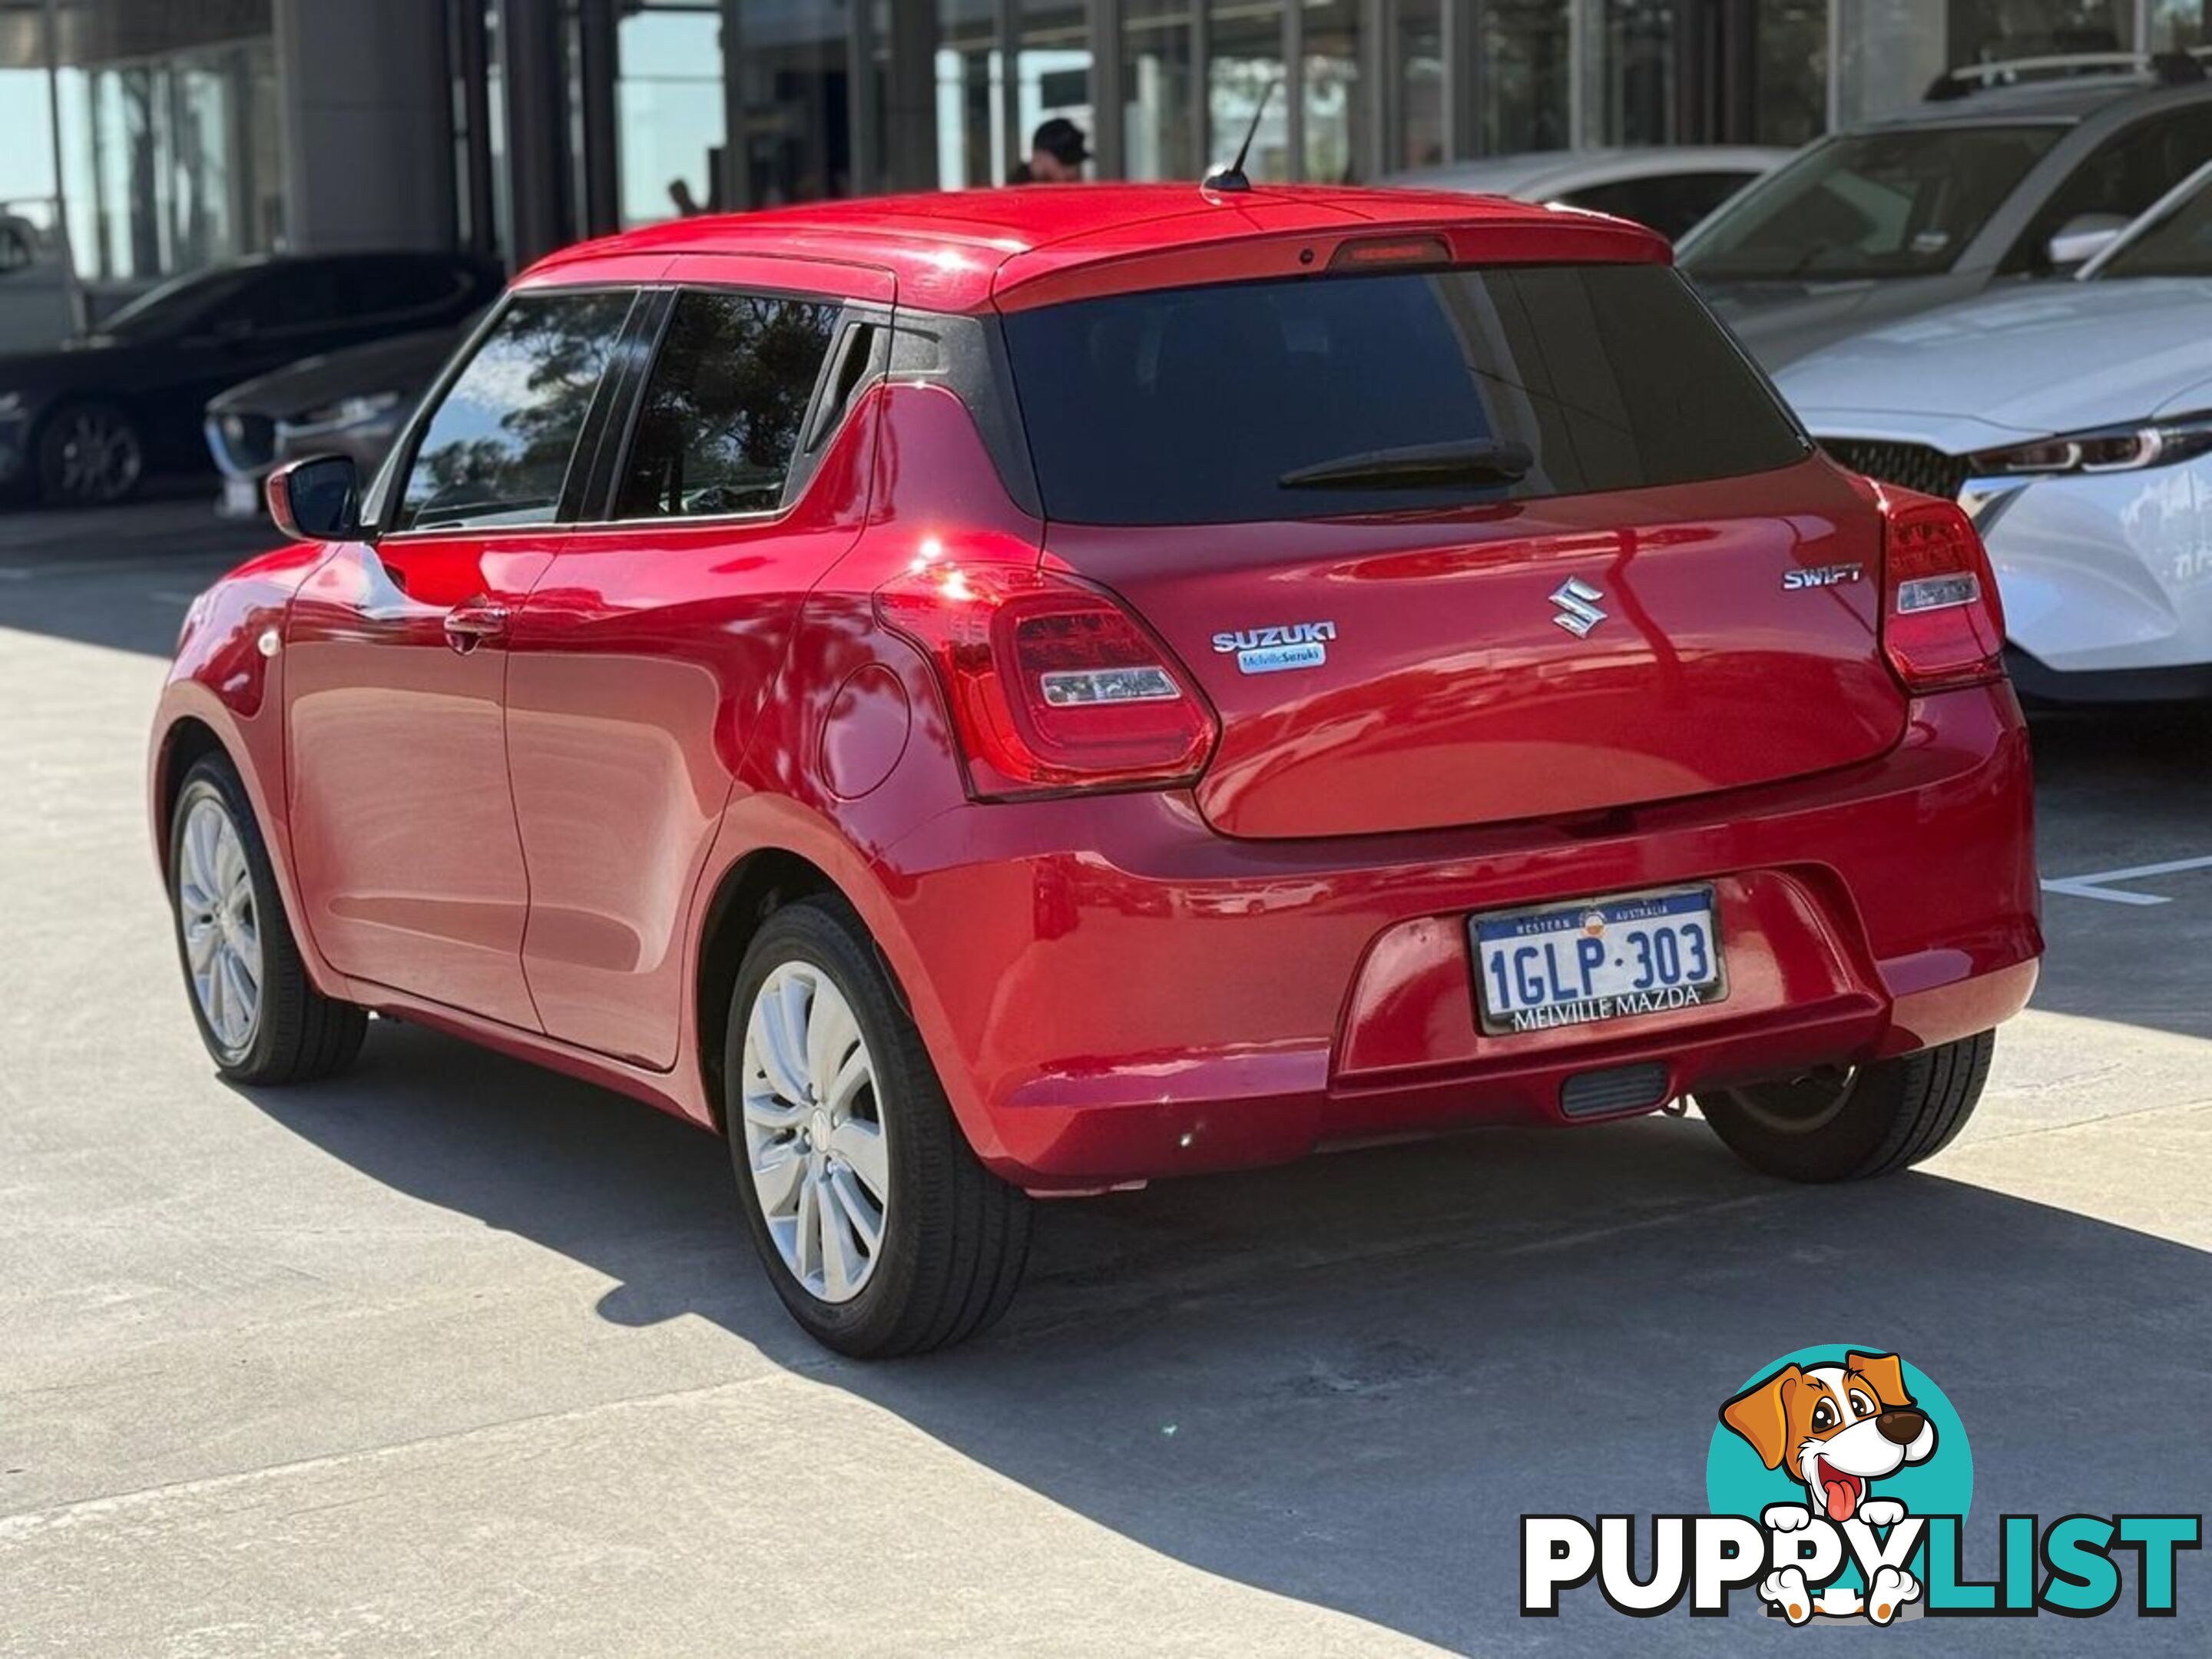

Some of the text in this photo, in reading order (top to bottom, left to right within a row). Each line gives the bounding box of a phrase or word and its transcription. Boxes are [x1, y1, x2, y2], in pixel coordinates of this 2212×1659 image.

[1783, 562, 1863, 589] SWIFT
[1212, 621, 1337, 653] SUZUKI
[1516, 905, 1668, 935] WESTERN AUSTRALIA
[1512, 985, 1701, 1031] MELVILLE MAZDA
